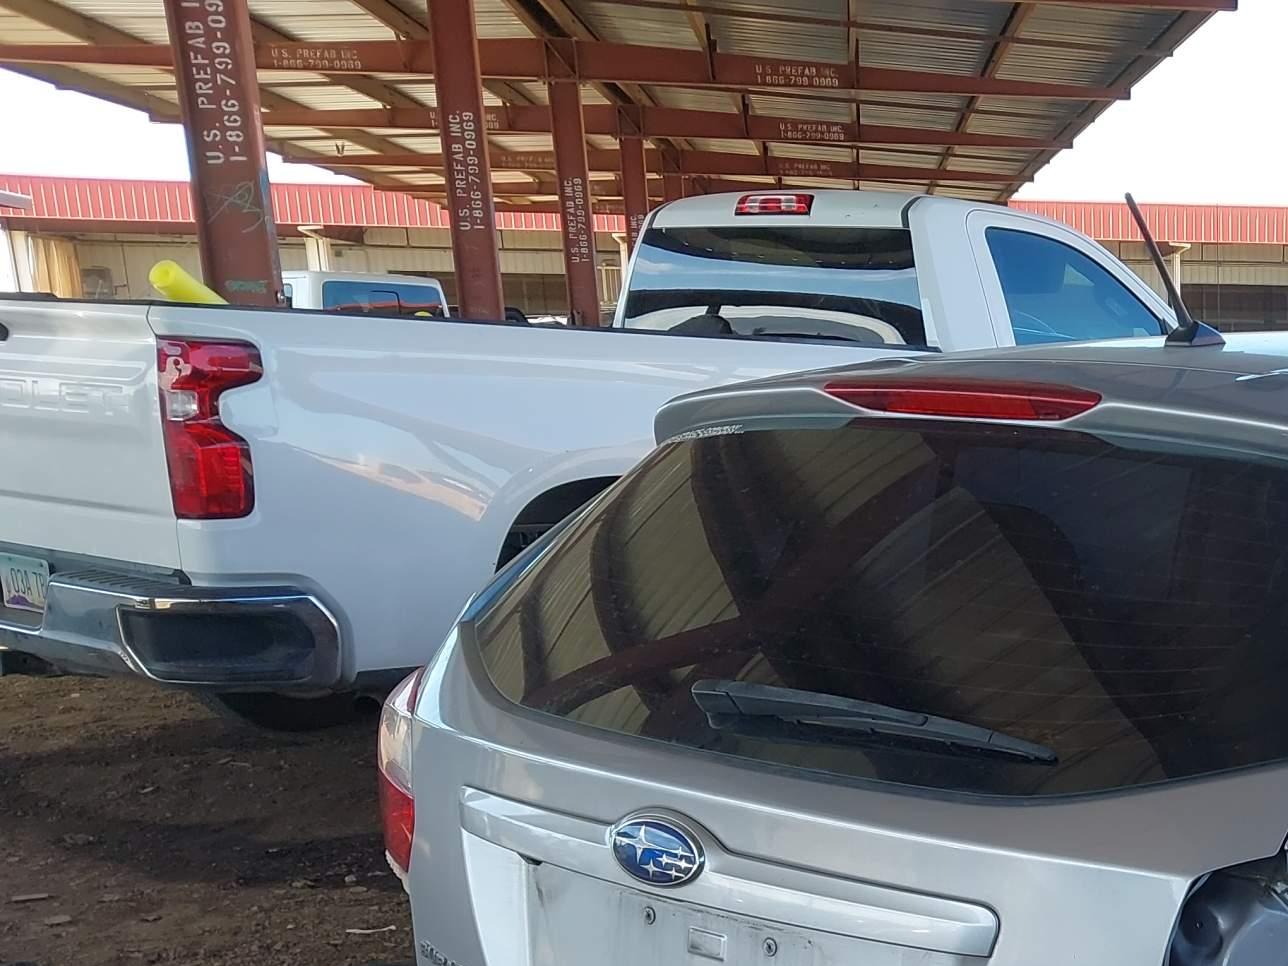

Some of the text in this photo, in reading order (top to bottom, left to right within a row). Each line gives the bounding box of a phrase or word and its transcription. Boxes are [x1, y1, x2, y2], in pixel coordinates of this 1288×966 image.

[185, 21, 217, 109] PREFAB
[203, 123, 225, 164] U.S.
[448, 110, 472, 230] U.S. PREFAB INC.
[462, 112, 485, 229] 1-866-799-0969
[566, 201, 578, 239] PREFAB
